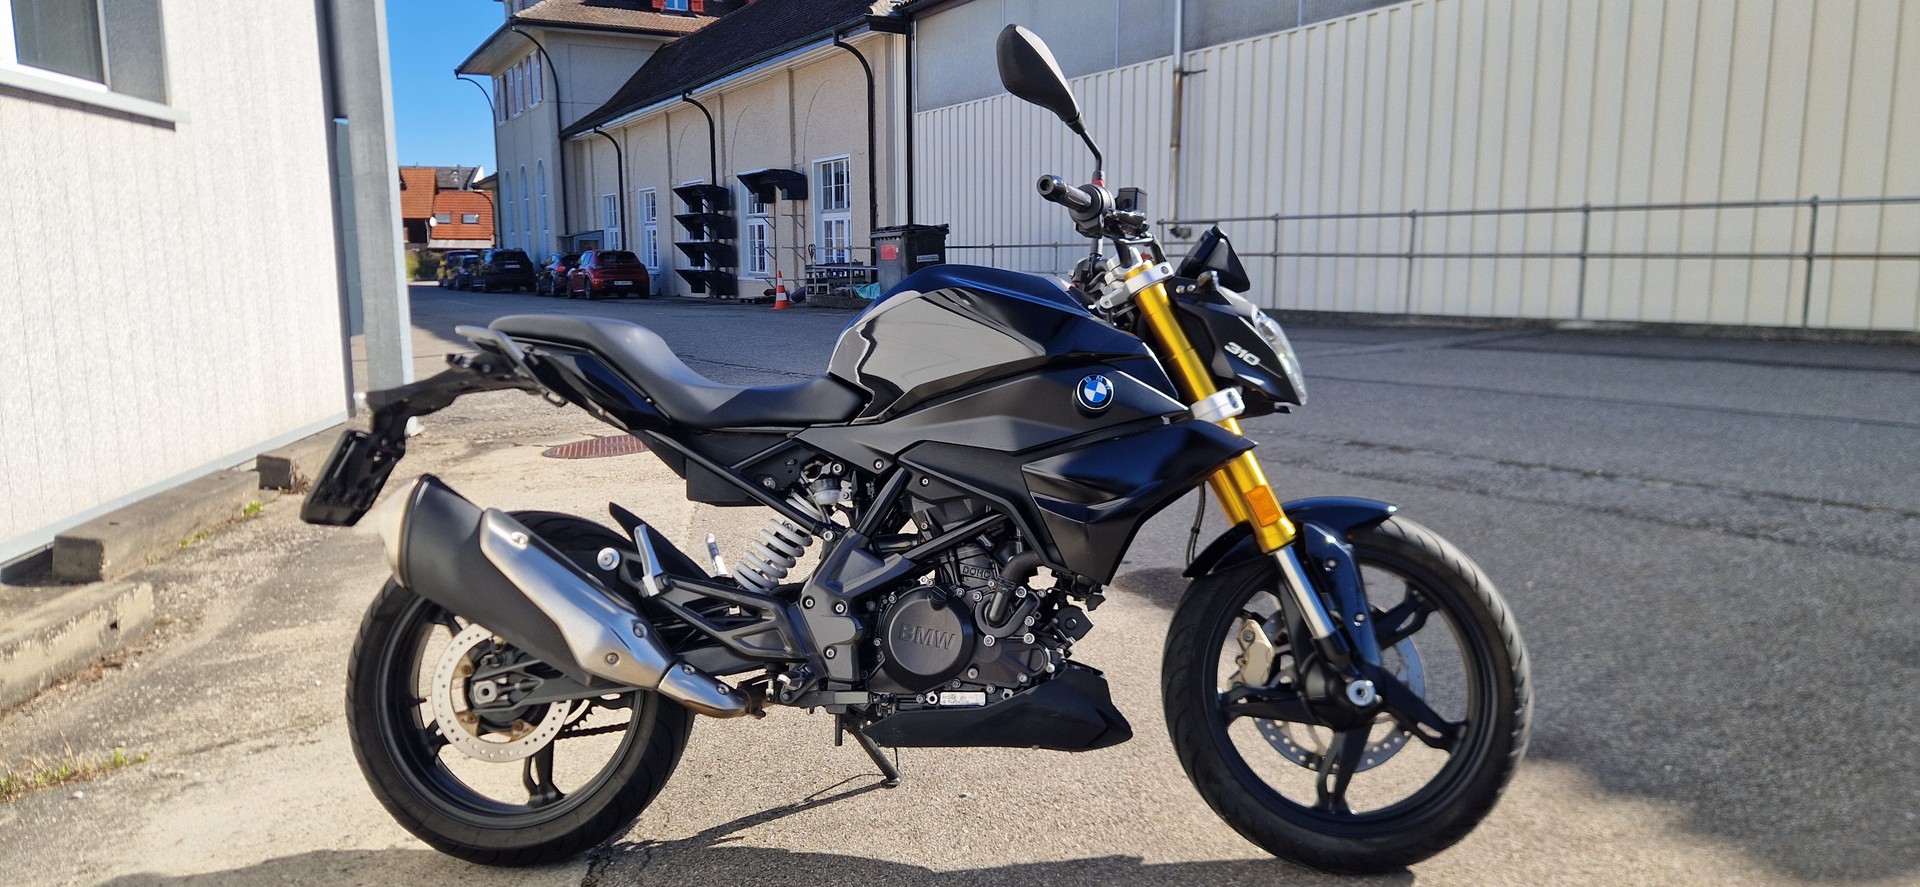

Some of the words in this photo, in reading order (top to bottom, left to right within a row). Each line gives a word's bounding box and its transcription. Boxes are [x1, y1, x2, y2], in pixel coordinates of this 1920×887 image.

[1224, 341, 1260, 366] 310
[962, 565, 991, 579] DOHC
[899, 623, 957, 651] BMW
